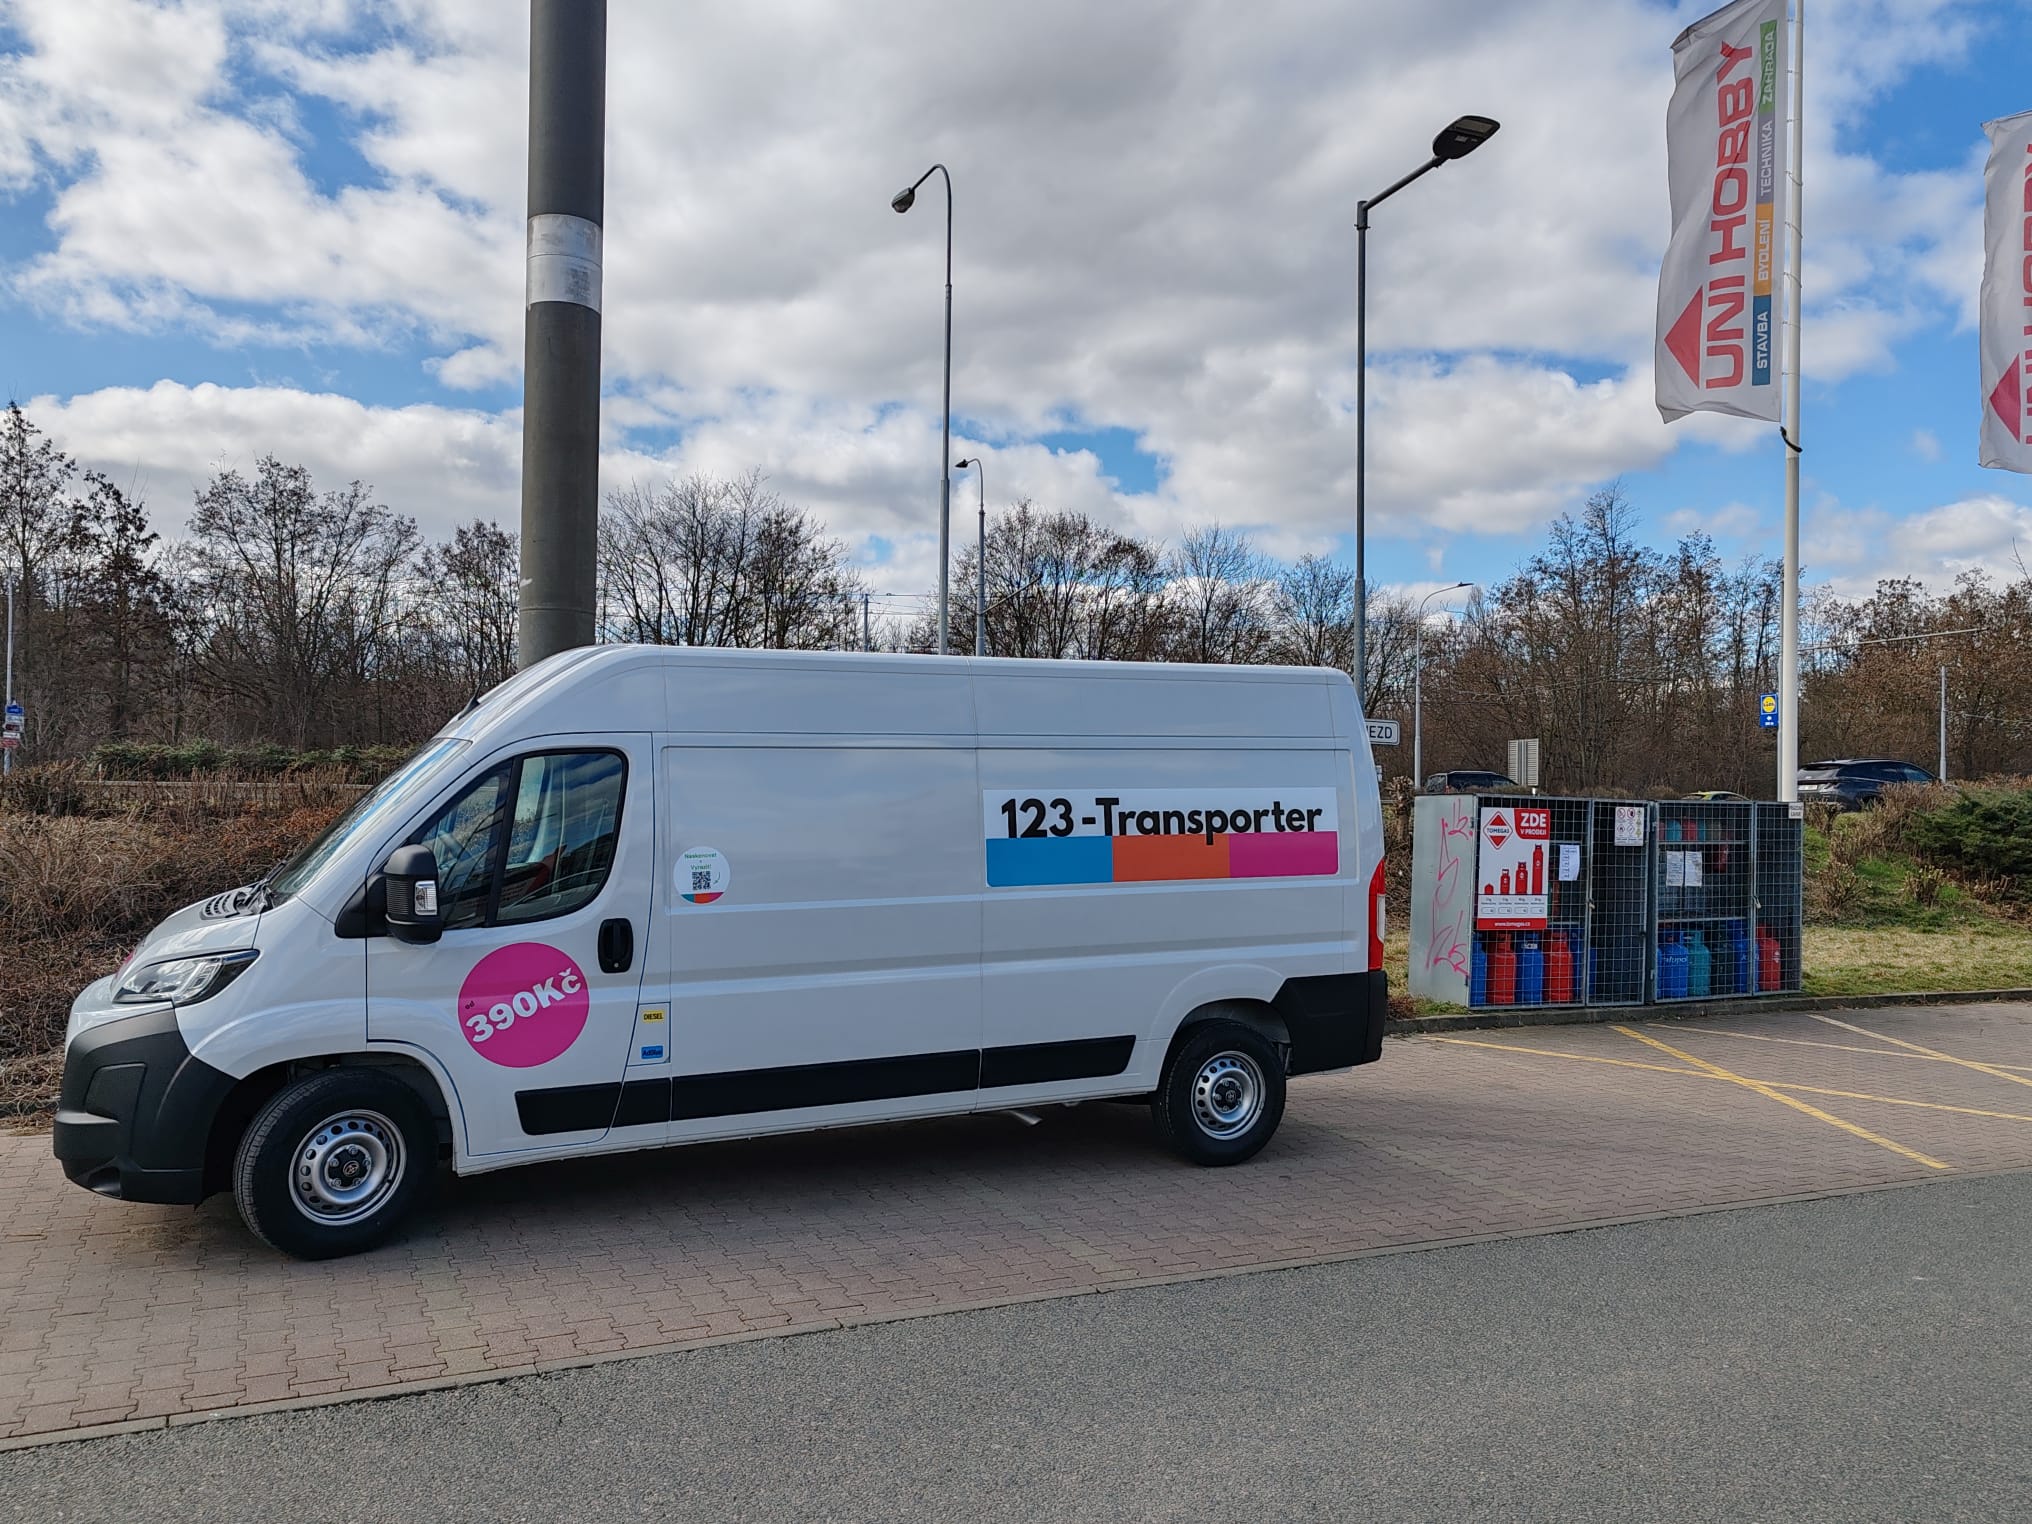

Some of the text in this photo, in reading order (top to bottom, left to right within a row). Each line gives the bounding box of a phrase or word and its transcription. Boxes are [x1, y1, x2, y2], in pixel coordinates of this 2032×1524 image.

[1756, 31, 1775, 370] STAVBA BYDLENÍ TECHNIKA ZAHRADA
[1705, 39, 1754, 390] UNI HOBBY
[1001, 797, 1322, 845] 123-Transporter
[1520, 812, 1547, 828] ZDE
[1486, 827, 1510, 835] TOMEGAS
[1525, 828, 1547, 836] PRODEJI
[643, 1012, 664, 1020] DIESEL
